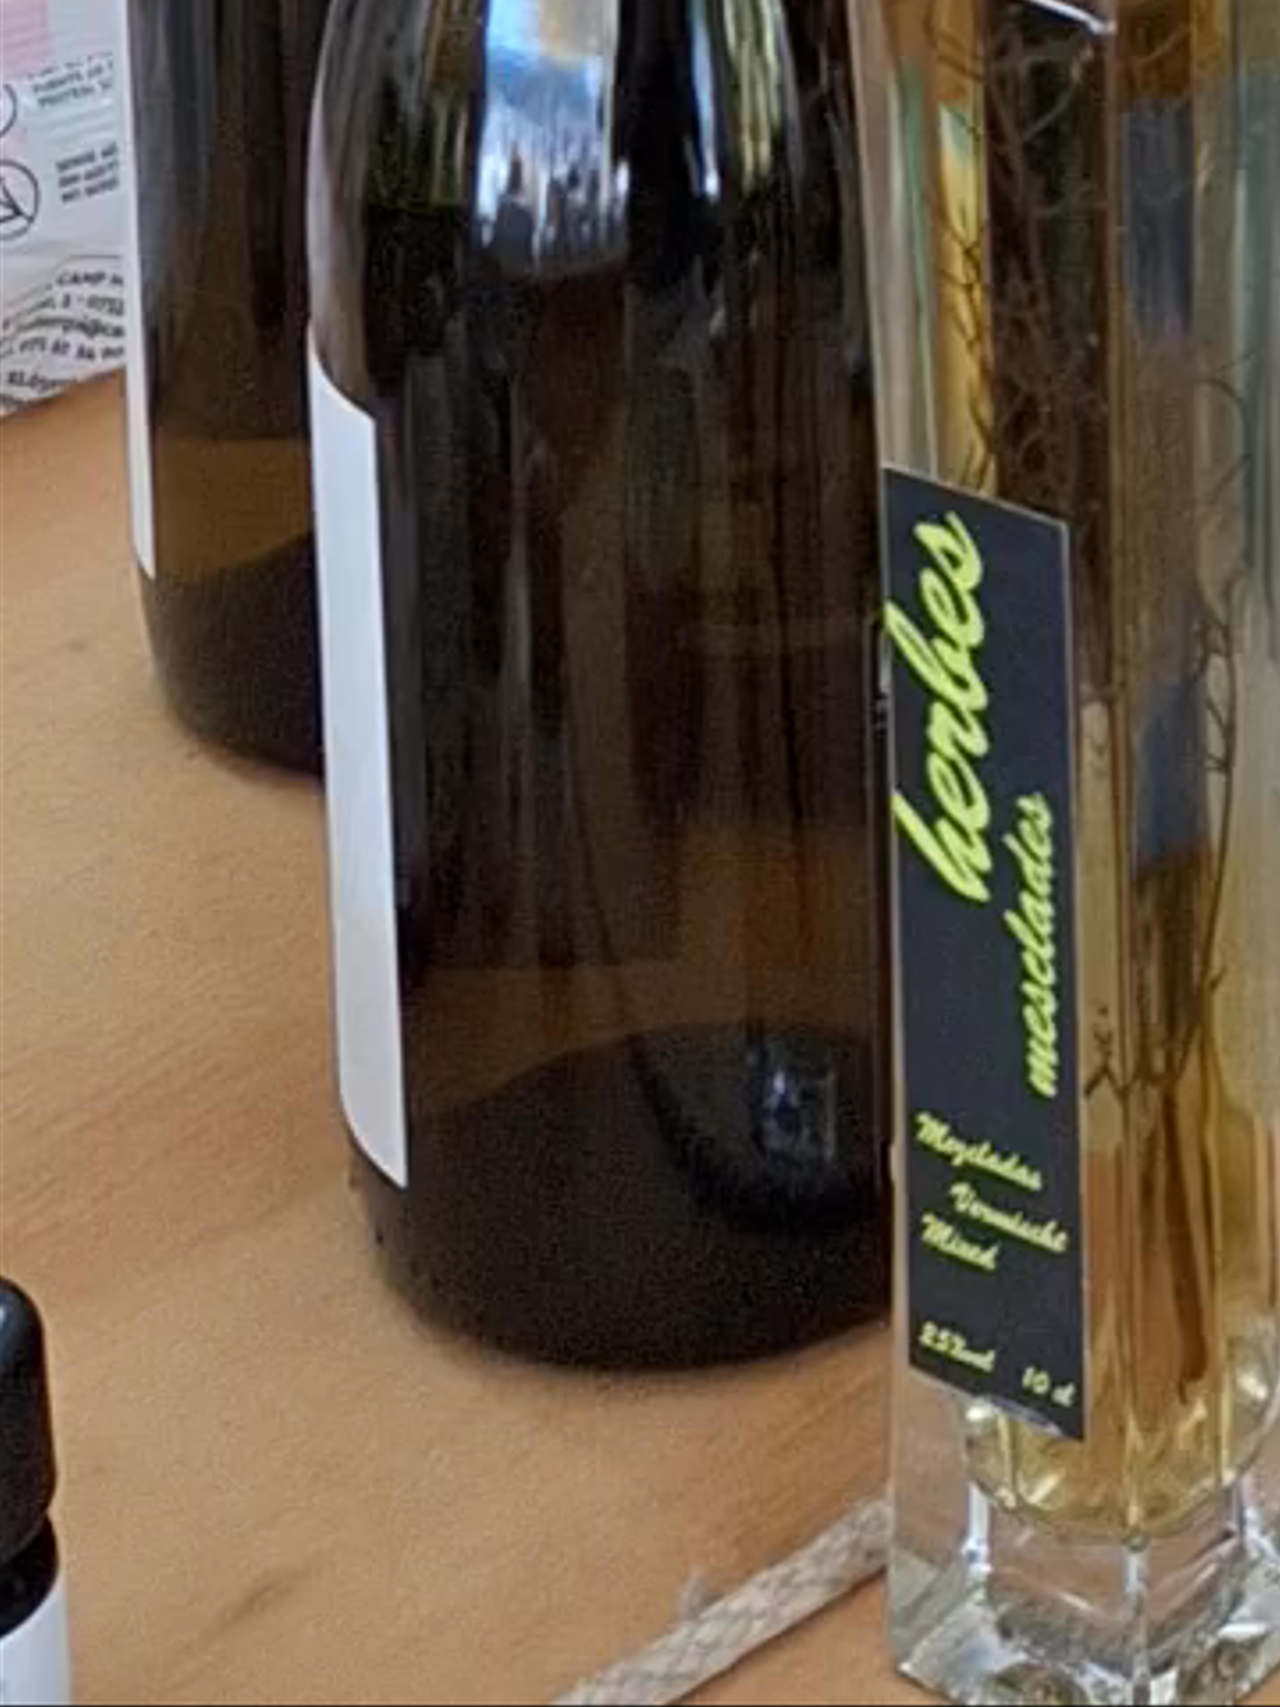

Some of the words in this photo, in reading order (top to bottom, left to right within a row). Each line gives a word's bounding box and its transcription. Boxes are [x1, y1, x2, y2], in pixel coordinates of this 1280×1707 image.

[883, 510, 993, 904] herbes
[1002, 791, 1058, 1098] mesclades
[921, 1213, 999, 1272] Mixed
